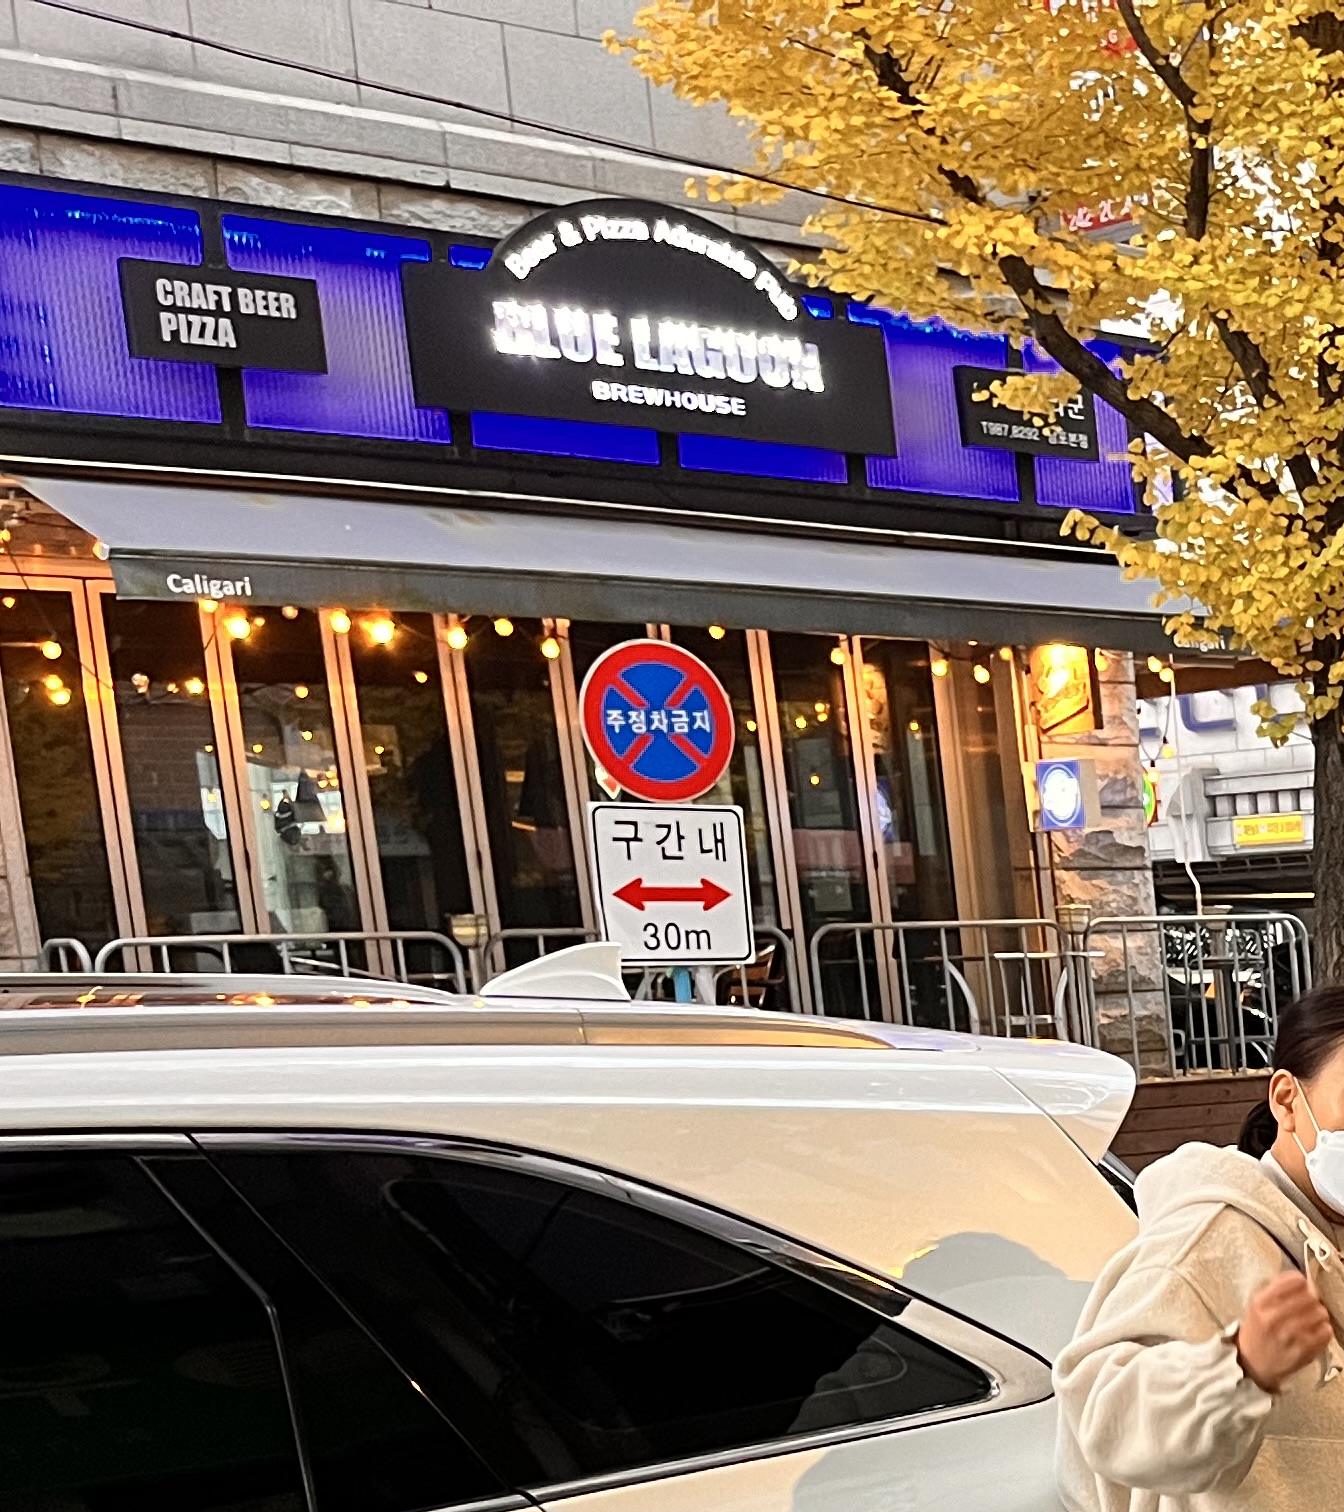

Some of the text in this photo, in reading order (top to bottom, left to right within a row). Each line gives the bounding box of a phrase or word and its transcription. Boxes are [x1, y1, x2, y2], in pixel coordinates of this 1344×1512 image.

[504, 214, 798, 322] Beer & Pizza Adorable Pub
[156, 278, 297, 319] CRAFT BEER
[159, 311, 237, 348] PIZZA
[490, 299, 625, 367] BLUE
[592, 379, 747, 416] BREWHOUSE
[166, 573, 252, 599] Caligari
[605, 709, 712, 735] 주정차금지
[642, 922, 713, 950] 30m
